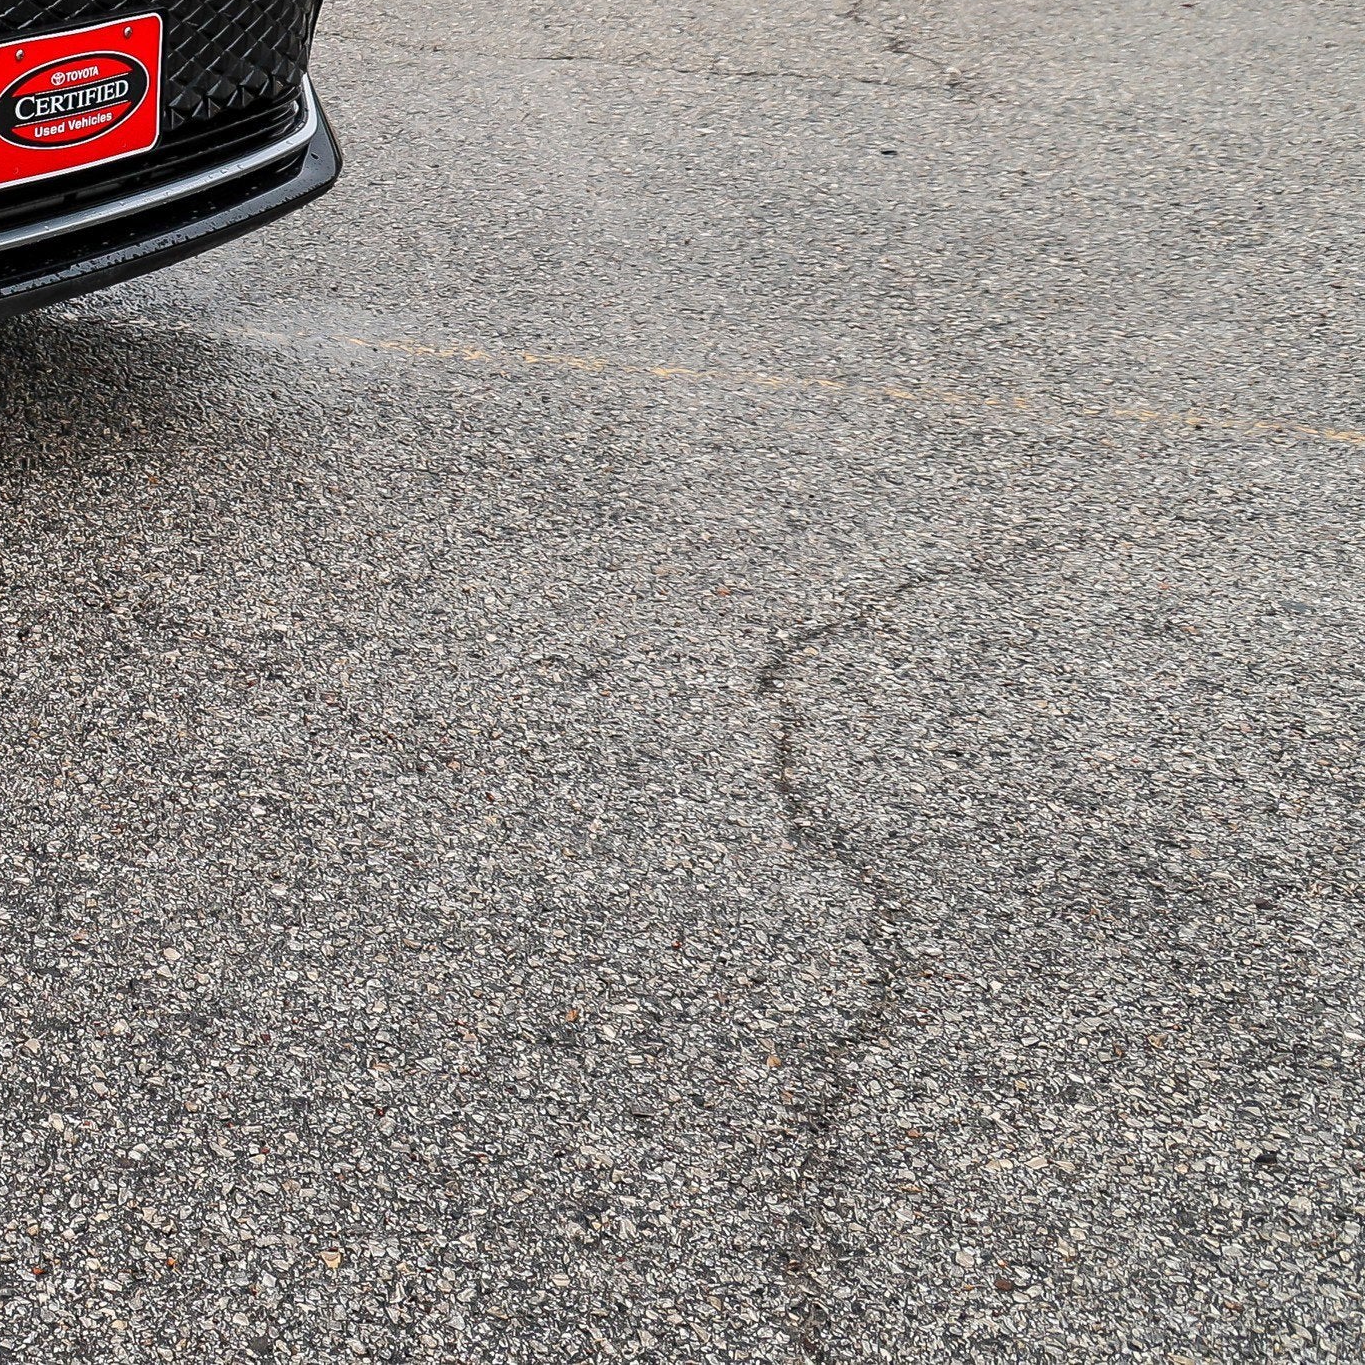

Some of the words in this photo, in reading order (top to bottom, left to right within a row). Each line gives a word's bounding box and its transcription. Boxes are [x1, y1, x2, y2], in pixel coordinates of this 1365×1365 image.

[64, 65, 100, 83] TOYOTA
[14, 79, 130, 121] CERTIFIED
[33, 121, 66, 139] Used
[68, 111, 114, 132] Vehicles
